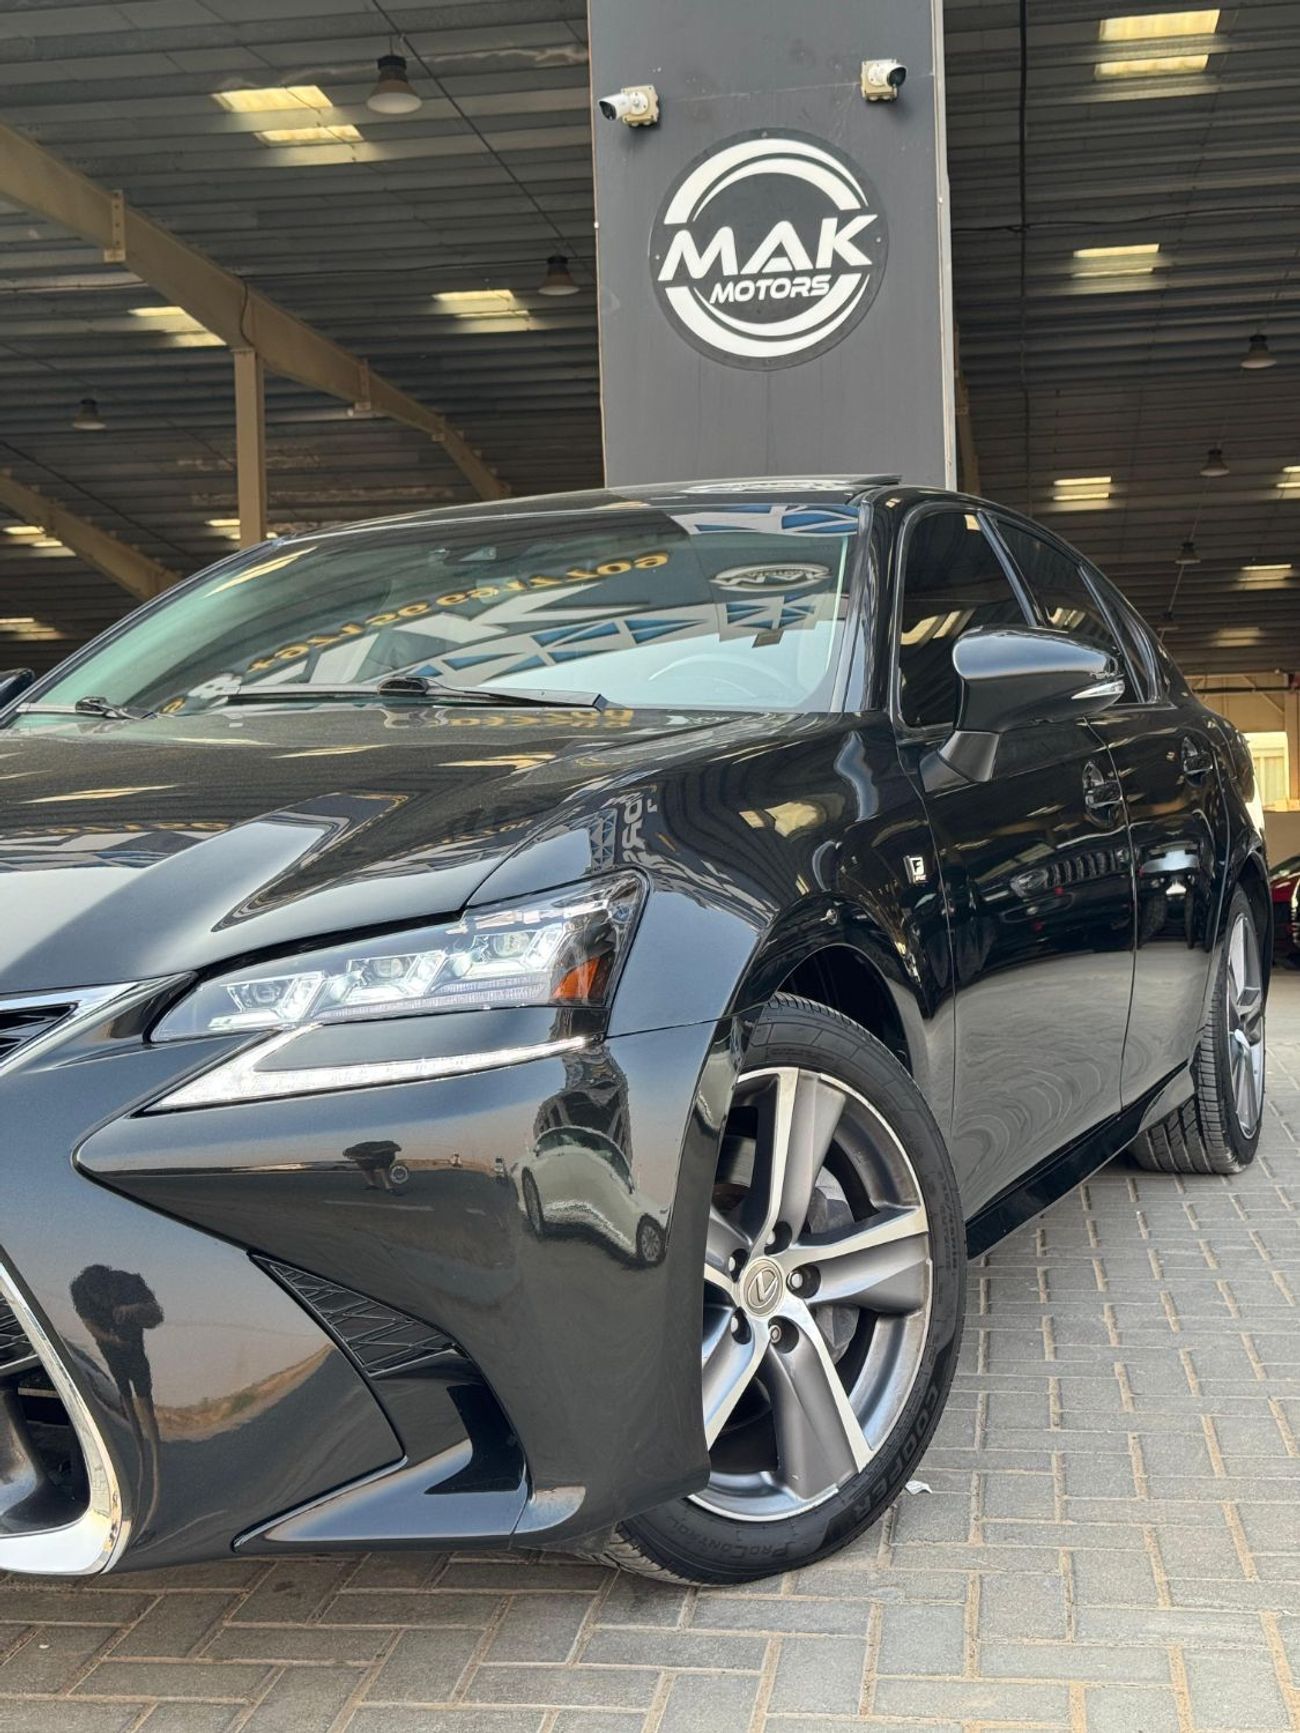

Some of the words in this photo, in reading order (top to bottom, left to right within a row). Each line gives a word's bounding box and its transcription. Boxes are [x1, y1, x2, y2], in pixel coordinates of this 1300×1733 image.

[657, 214, 878, 281] MAK
[709, 274, 832, 304] MOTORS
[854, 1383, 939, 1521] COOPER
